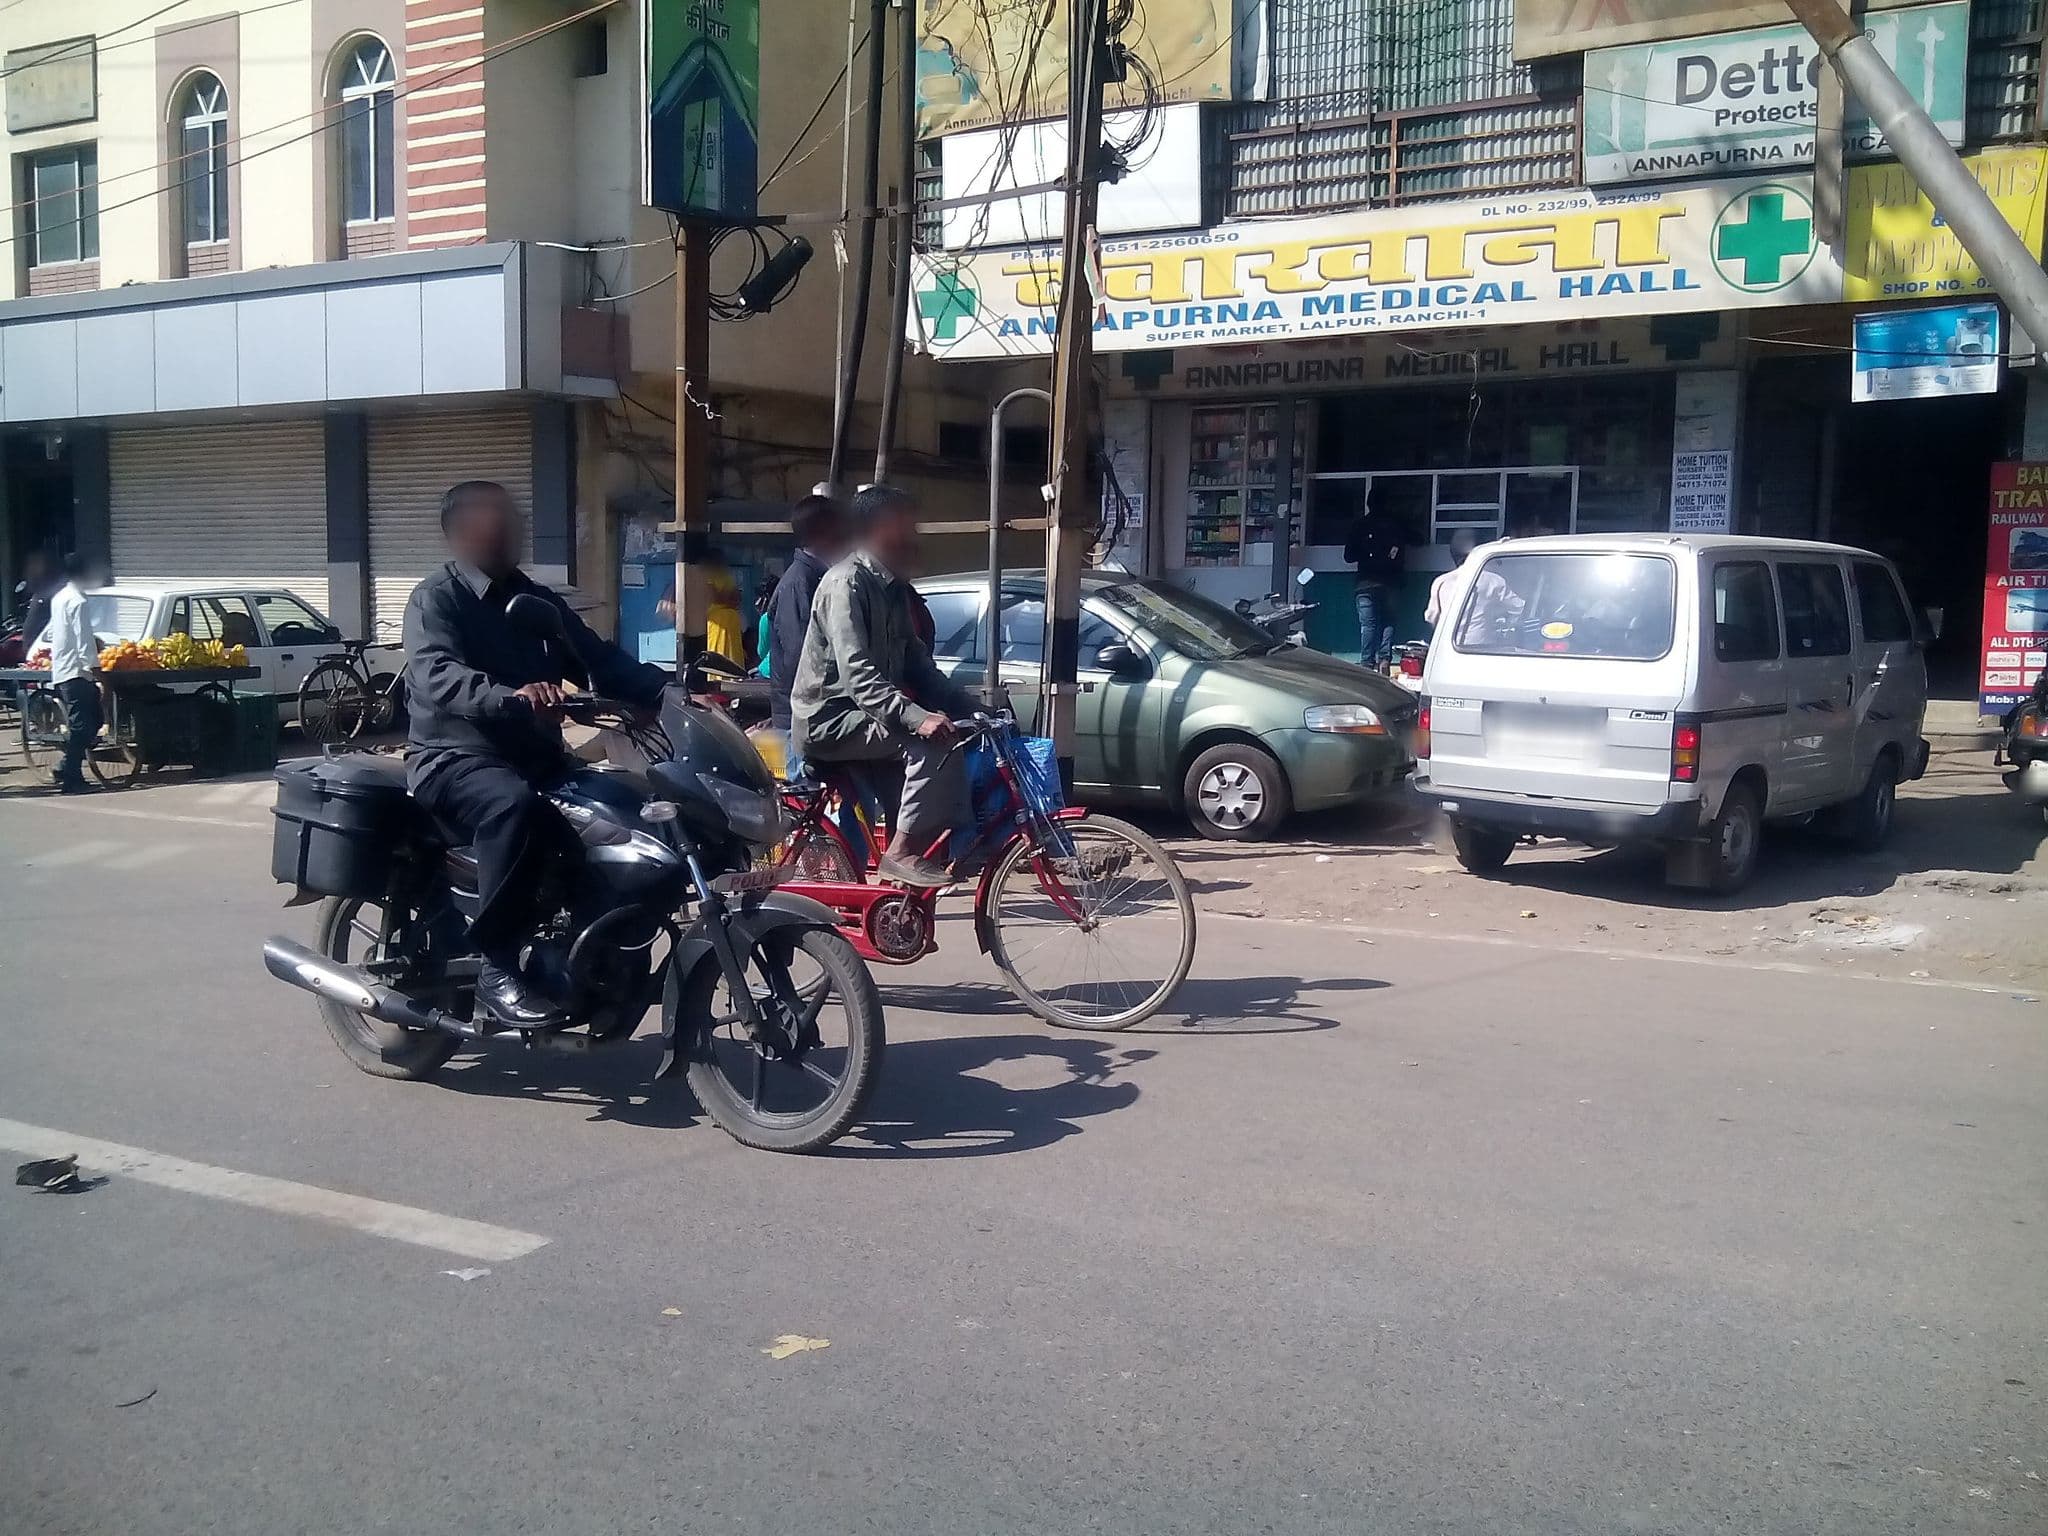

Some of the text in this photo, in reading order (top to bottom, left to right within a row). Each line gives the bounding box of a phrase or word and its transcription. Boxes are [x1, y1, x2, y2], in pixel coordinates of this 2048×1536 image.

[1676, 45, 1819, 105] Dett
[1715, 100, 1818, 127] Protects
[1633, 146, 1783, 173] ANNAPURNA
[1481, 206, 1501, 217] DL
[1537, 197, 1592, 213] 232/99,
[1102, 232, 1240, 254] 651-2560650
[1883, 281, 1930, 294] SHOP
[1935, 279, 1965, 291] NO.
[998, 268, 1701, 337] ANAPURNA MEDICAL HALL
[1146, 309, 1486, 342] SUPER MARKET, LALPUR, RANCHI-1
[1185, 341, 1630, 390] ANNAPURNA MEDICAL HALL
[1677, 454, 1728, 467] HOME TUITION
[1676, 480, 1727, 488] 94713-71074
[2016, 466, 2048, 486] BA
[1674, 493, 1726, 506] HOME TUITION
[1994, 489, 2048, 508] TRA
[1674, 519, 1725, 528] 94713-71074
[1992, 513, 2046, 525] RAILWAY
[1996, 575, 2026, 587] AIR
[1990, 637, 2009, 648] ALL
[2012, 636, 2034, 647] DTH
[1985, 695, 2014, 704] Mob:
[1631, 711, 1666, 720] Omni
[730, 870, 779, 891] POLIC
